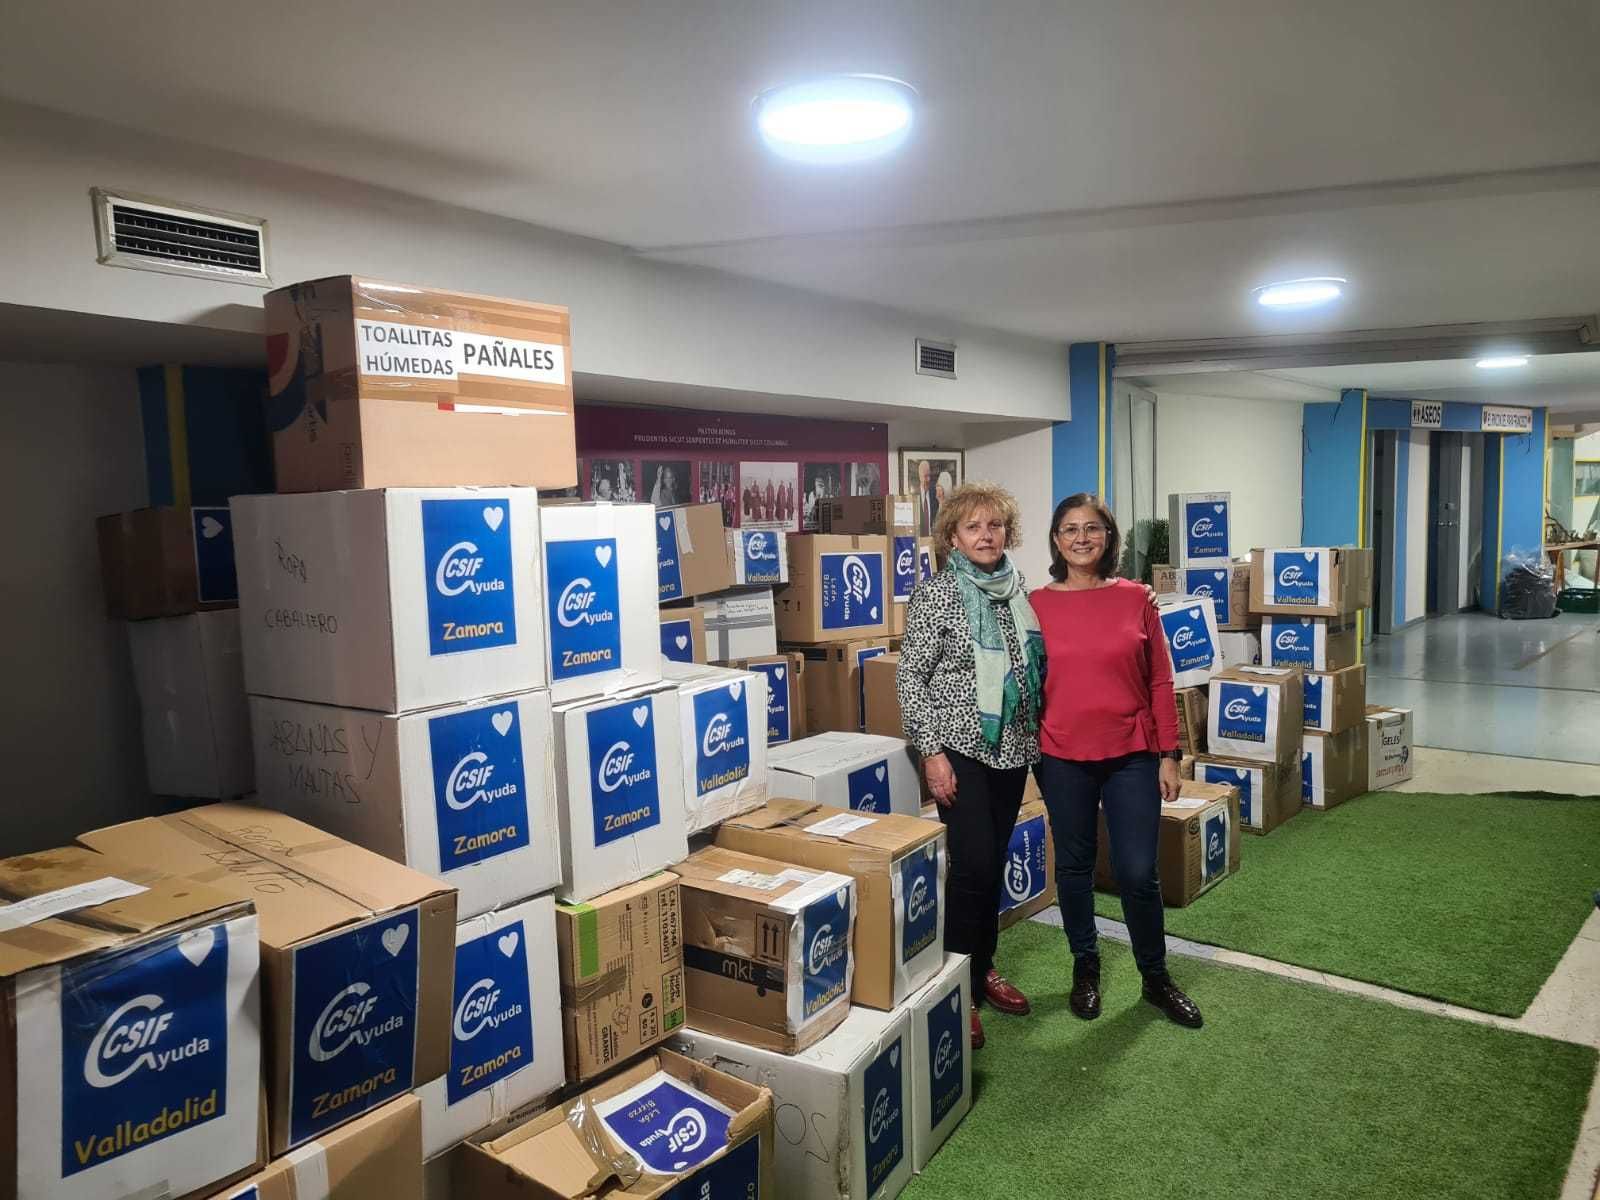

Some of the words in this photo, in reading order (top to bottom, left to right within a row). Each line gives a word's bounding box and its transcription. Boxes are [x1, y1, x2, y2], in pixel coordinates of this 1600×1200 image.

[361, 325, 453, 348] TOALLITAS
[366, 351, 454, 375] HÚMEDAS
[463, 340, 554, 370] PAÑALES
[1421, 405, 1441, 424] ASEOS
[752, 541, 768, 551] CSIF
[445, 557, 484, 578] CSIF
[747, 572, 779, 583] Valladolid
[1284, 571, 1303, 579] CSIF
[463, 578, 504, 595] Ayuda
[852, 565, 863, 605] CSIF
[565, 592, 596, 611] CSIF
[843, 588, 852, 620] Ayuda
[579, 610, 613, 626] Ayuda
[443, 621, 504, 641] Zamora
[1177, 630, 1194, 642] CSIF
[562, 649, 612, 667] Zamora
[1180, 653, 1209, 667] Zamora
[1230, 704, 1251, 714] CSIF
[1240, 715, 1261, 723] Ayuda
[708, 722, 732, 743] CSIF
[720, 737, 745, 752] Ayuda
[1221, 729, 1264, 741] Valladolid
[605, 753, 634, 777] CSIF
[455, 764, 495, 792] CSIF
[620, 768, 651, 787] Ayuda
[700, 764, 747, 792] Valladolid
[475, 783, 518, 804] Ayuda
[604, 806, 651, 831] Zamora
[454, 825, 518, 855] Zamora
[1023, 830, 1031, 865] Ayuda
[1013, 852, 1023, 892] CSIF
[911, 885, 928, 908] CSIF
[814, 934, 834, 960] CSIF
[463, 989, 501, 1022] CSIF
[806, 977, 845, 1016] Valladolid
[323, 996, 378, 1038] CSIF
[482, 1004, 522, 1028] Ayuda
[103, 1012, 174, 1060] CSIF
[349, 1015, 403, 1046] Ayuda
[138, 1037, 210, 1071] Ayuda
[460, 1046, 521, 1086] Zamora
[311, 1068, 396, 1119] Zamora
[627, 1099, 656, 1118] Bierzo
[873, 1096, 890, 1127] CSIF
[74, 1089, 217, 1165] Valladolid
[639, 1129, 670, 1147] Ayuda
[668, 1120, 698, 1153] CSIF
